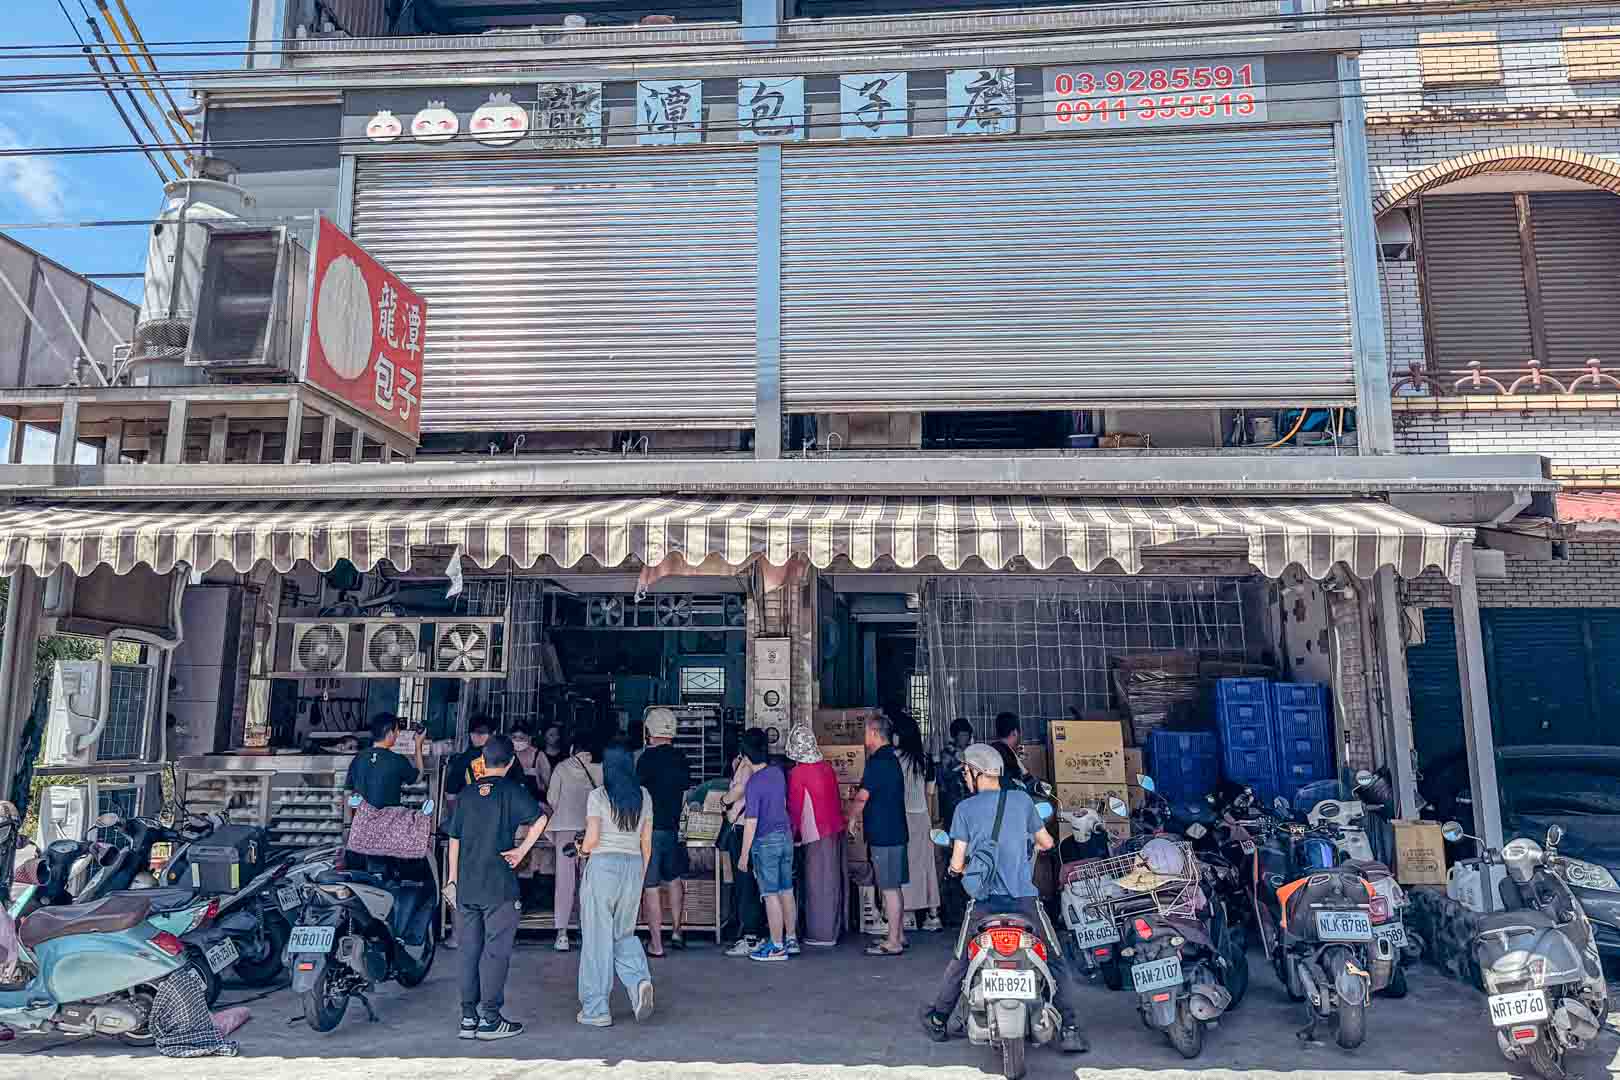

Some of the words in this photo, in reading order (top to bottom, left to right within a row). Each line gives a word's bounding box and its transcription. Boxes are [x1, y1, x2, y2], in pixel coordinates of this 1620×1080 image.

[1055, 63, 1253, 95] 03-9285591
[1056, 98, 1126, 124] 0911
[1138, 93, 1255, 120] 355513
[378, 281, 421, 361] 龍潭
[374, 352, 418, 420] 包子
[984, 977, 1032, 993] MKB-8921
[1491, 997, 1544, 1019] NRT-8760
